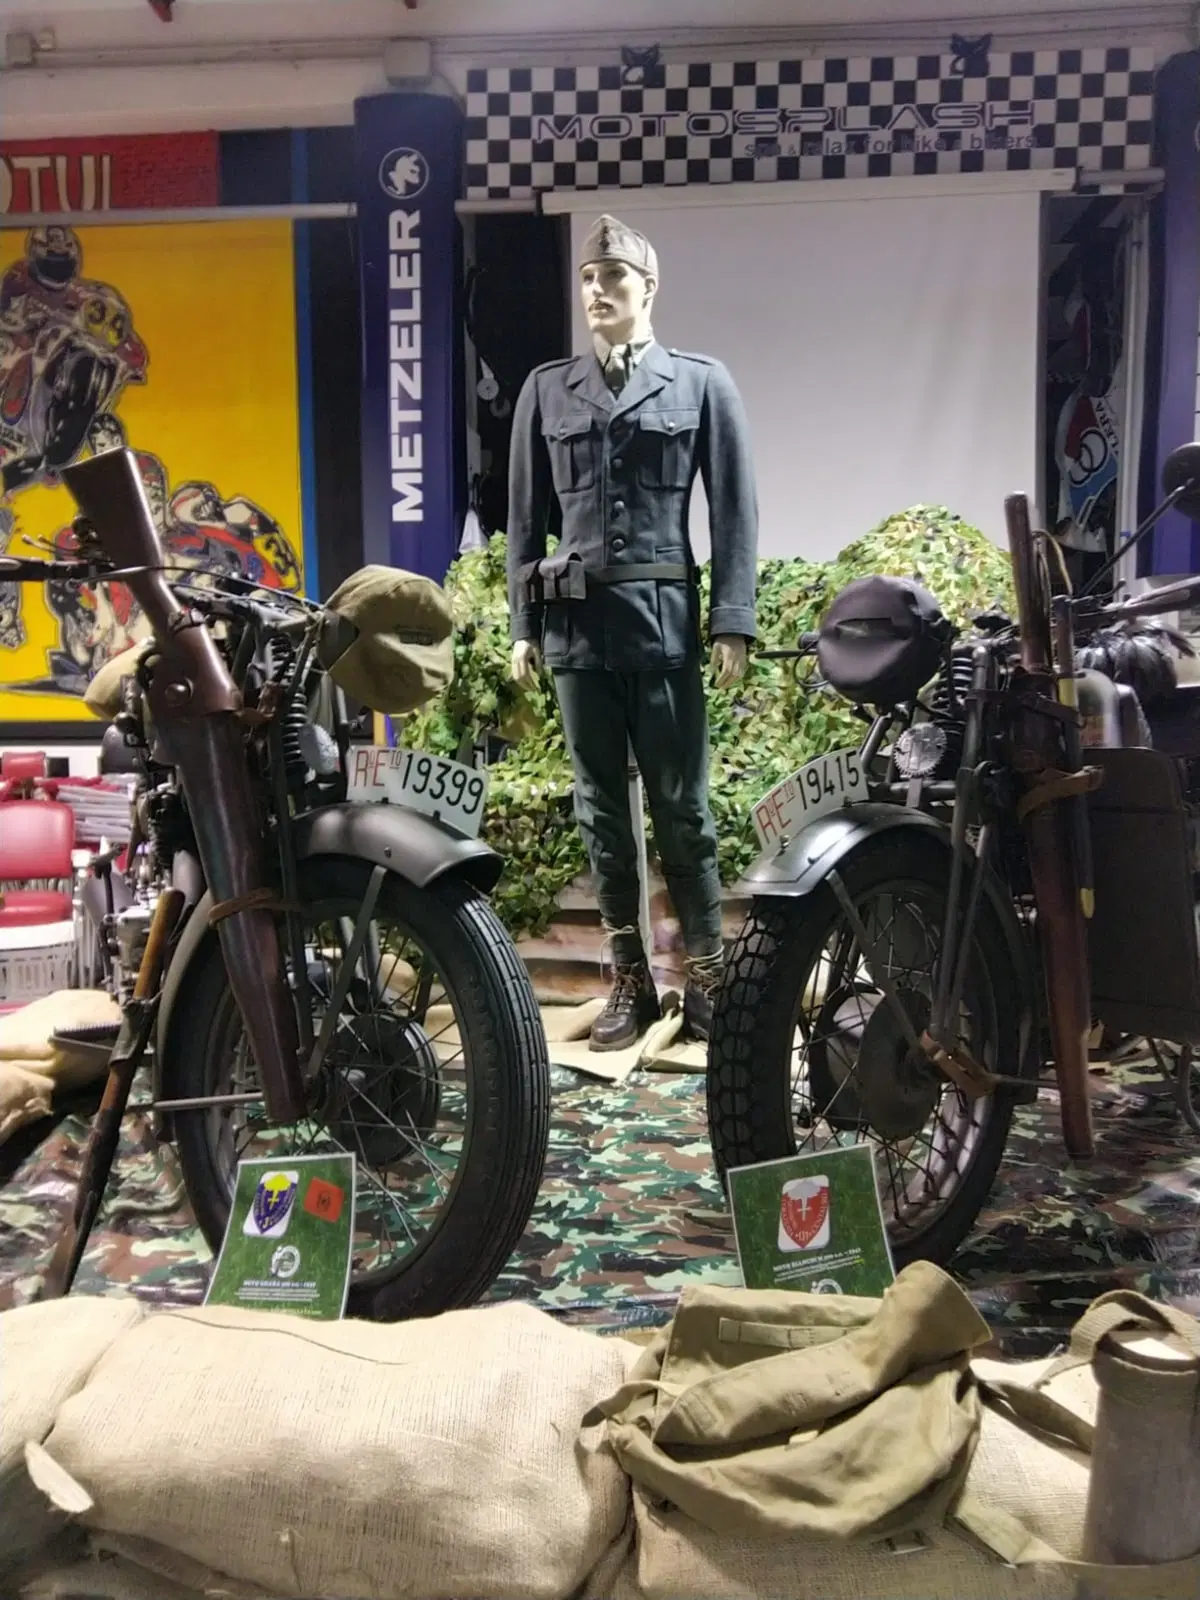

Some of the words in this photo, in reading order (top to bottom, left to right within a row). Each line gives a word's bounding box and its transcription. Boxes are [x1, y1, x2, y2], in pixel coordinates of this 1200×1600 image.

[536, 101, 1036, 142] MOTOSPLASH
[388, 208, 424, 522] METZELER
[401, 753, 484, 814] 19399
[796, 750, 860, 811] 19415
